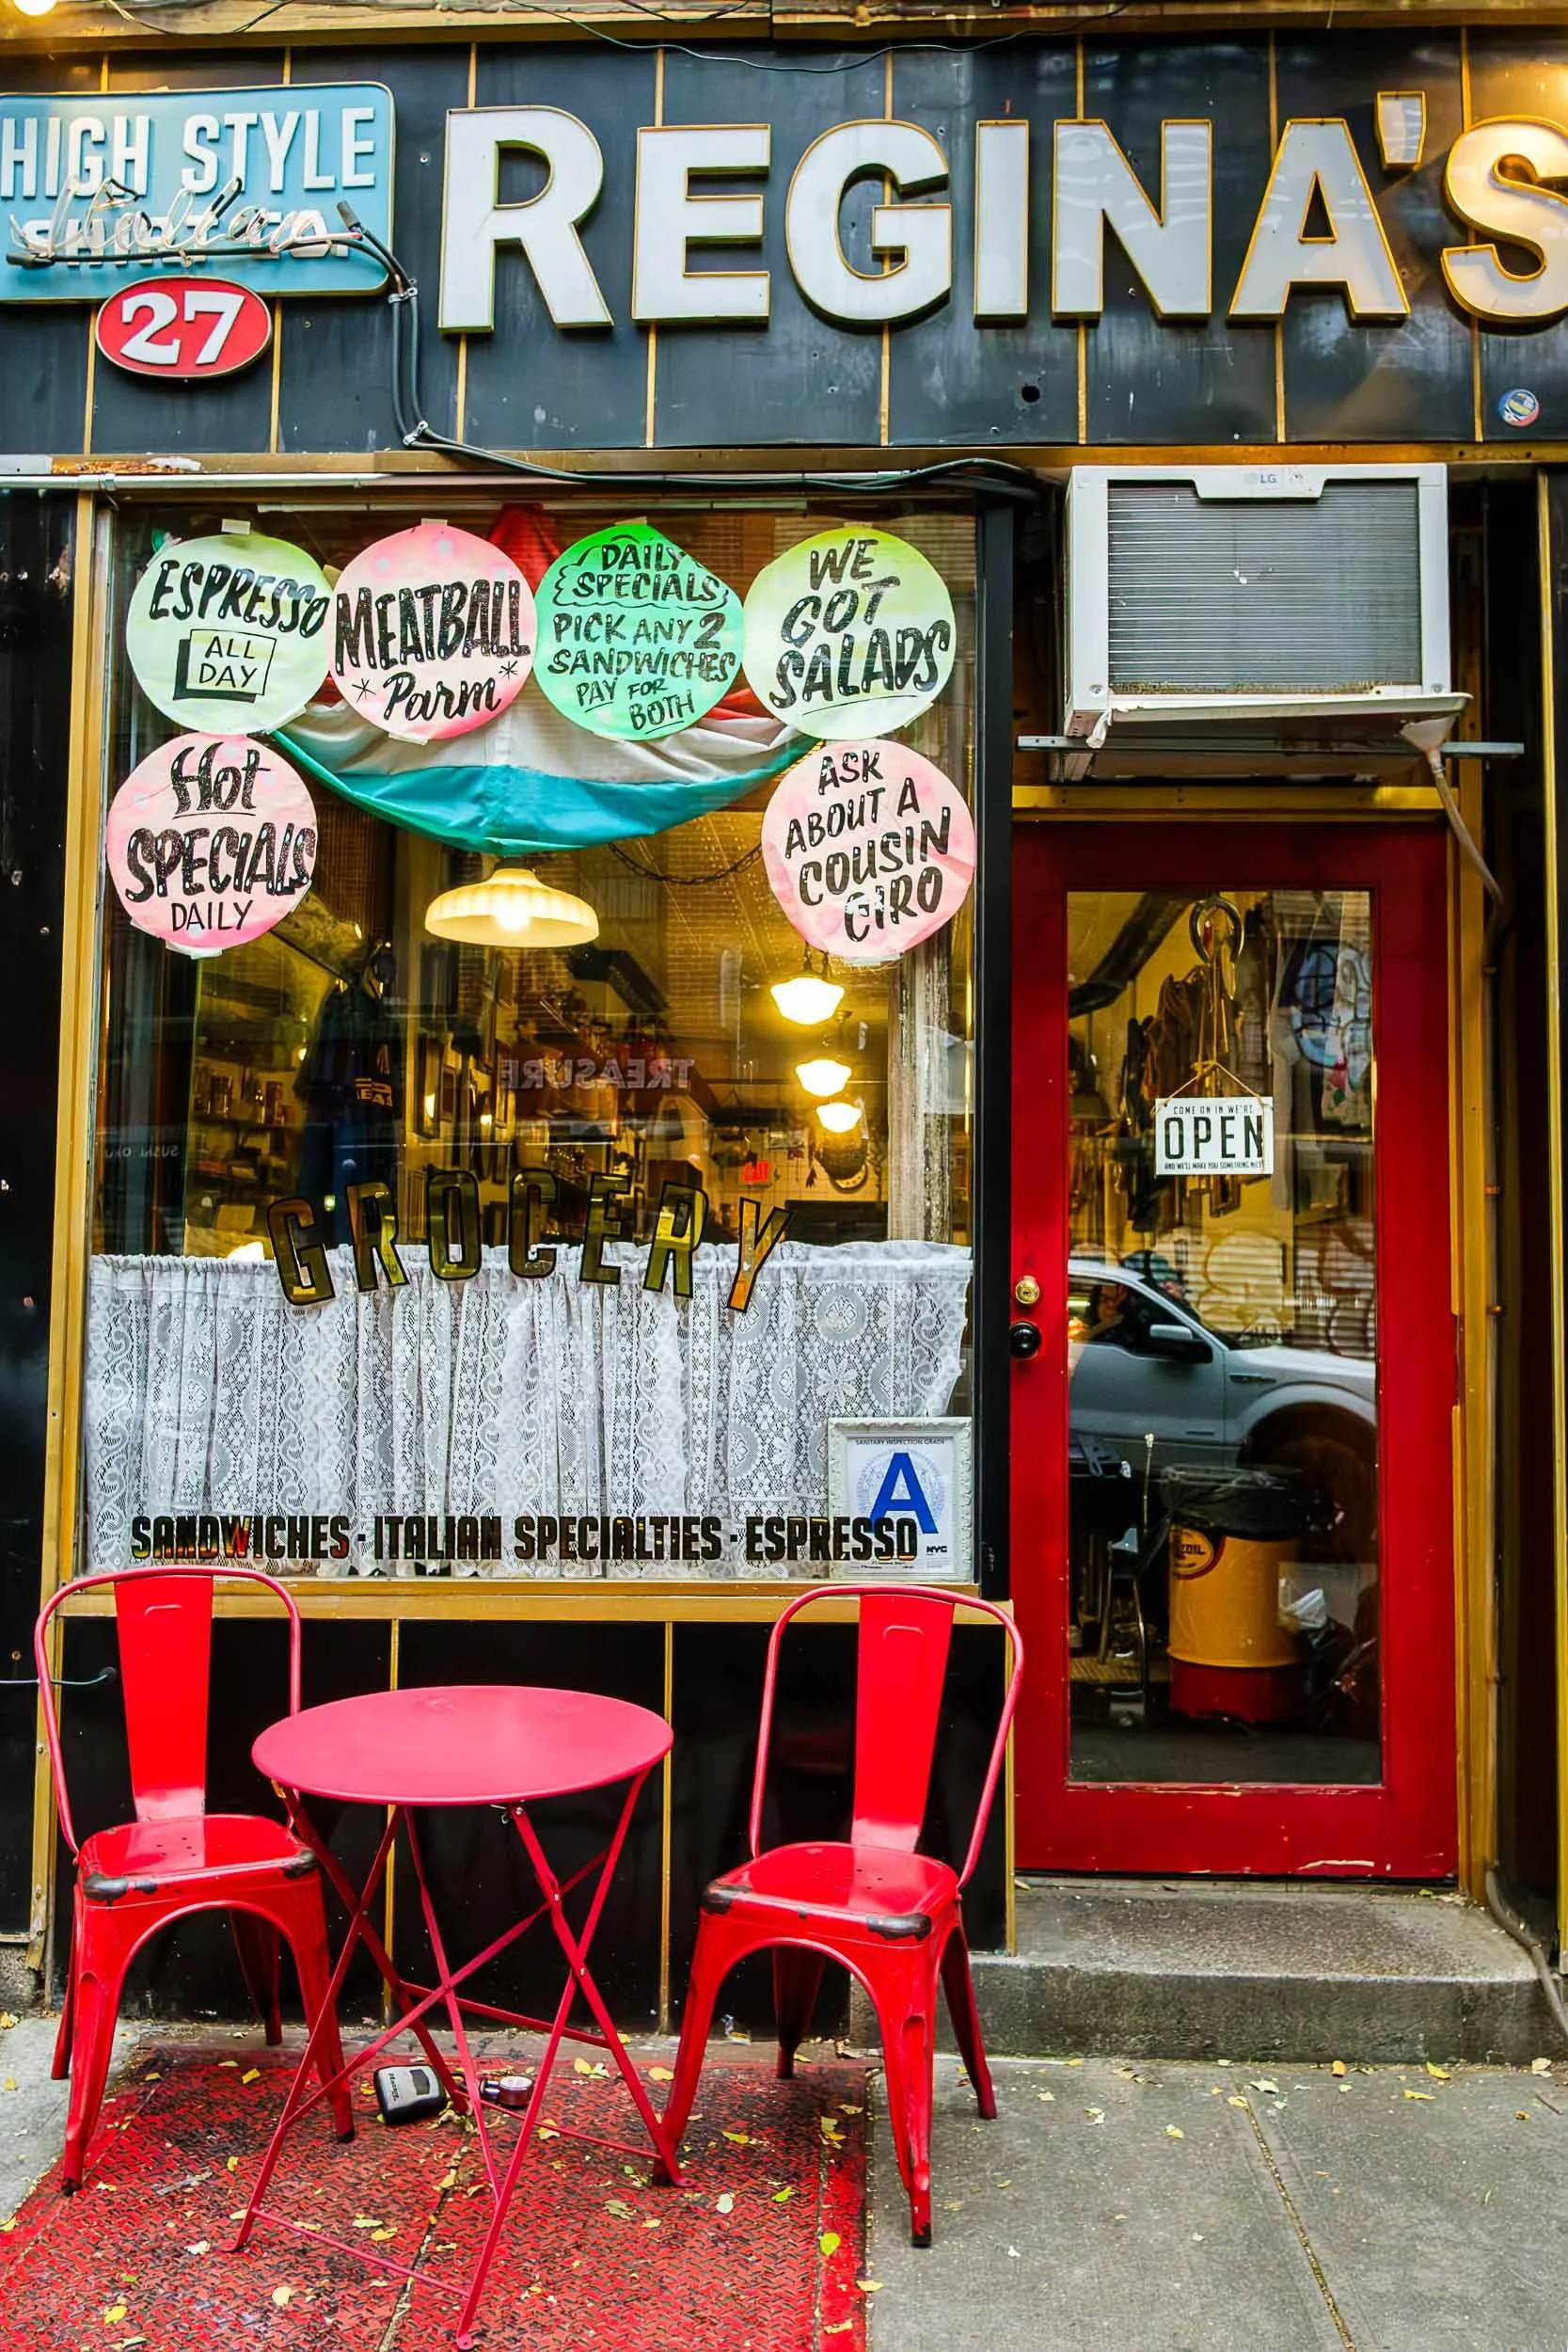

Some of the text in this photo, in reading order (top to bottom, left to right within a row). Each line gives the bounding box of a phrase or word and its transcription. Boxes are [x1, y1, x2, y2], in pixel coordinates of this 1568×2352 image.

[1, 107, 375, 199] HIGH STYLE
[436, 90, 1568, 335] REGINA'S
[119, 291, 245, 366] 27
[1260, 473, 1276, 484] LG
[602, 541, 687, 571] DAILY
[810, 538, 879, 591] WE
[149, 559, 329, 639] ESPRESSO
[573, 571, 721, 602] SPECIALS
[335, 580, 531, 676] MEATBALL
[553, 612, 726, 649] PICK ANY 2
[780, 576, 900, 649] GOT
[204, 636, 256, 660] ALL
[547, 648, 736, 683] SANDWICHES
[769, 619, 951, 709] SALADS
[198, 662, 258, 688] DAY
[383, 671, 502, 723] Parm
[577, 676, 669, 707] PAY FOR
[628, 691, 695, 731] BOTH
[818, 750, 884, 796] ASK
[784, 777, 920, 859] ABOUT A
[125, 822, 316, 902] SPECIALS
[800, 806, 951, 906] COUSIN
[171, 900, 253, 931] DAILY
[844, 866, 942, 942] CIRO
[1173, 1104, 1253, 1115] COME ON IN WE'RE
[1164, 1116, 1262, 1159] OPEN
[266, 1168, 792, 1313] GROCERY
[868, 1453, 939, 1534] A
[131, 1516, 917, 1561] SANDWICHES ITALIAN SPECIALTIES ESPRESSO
[926, 1545, 947, 1553] NYC
